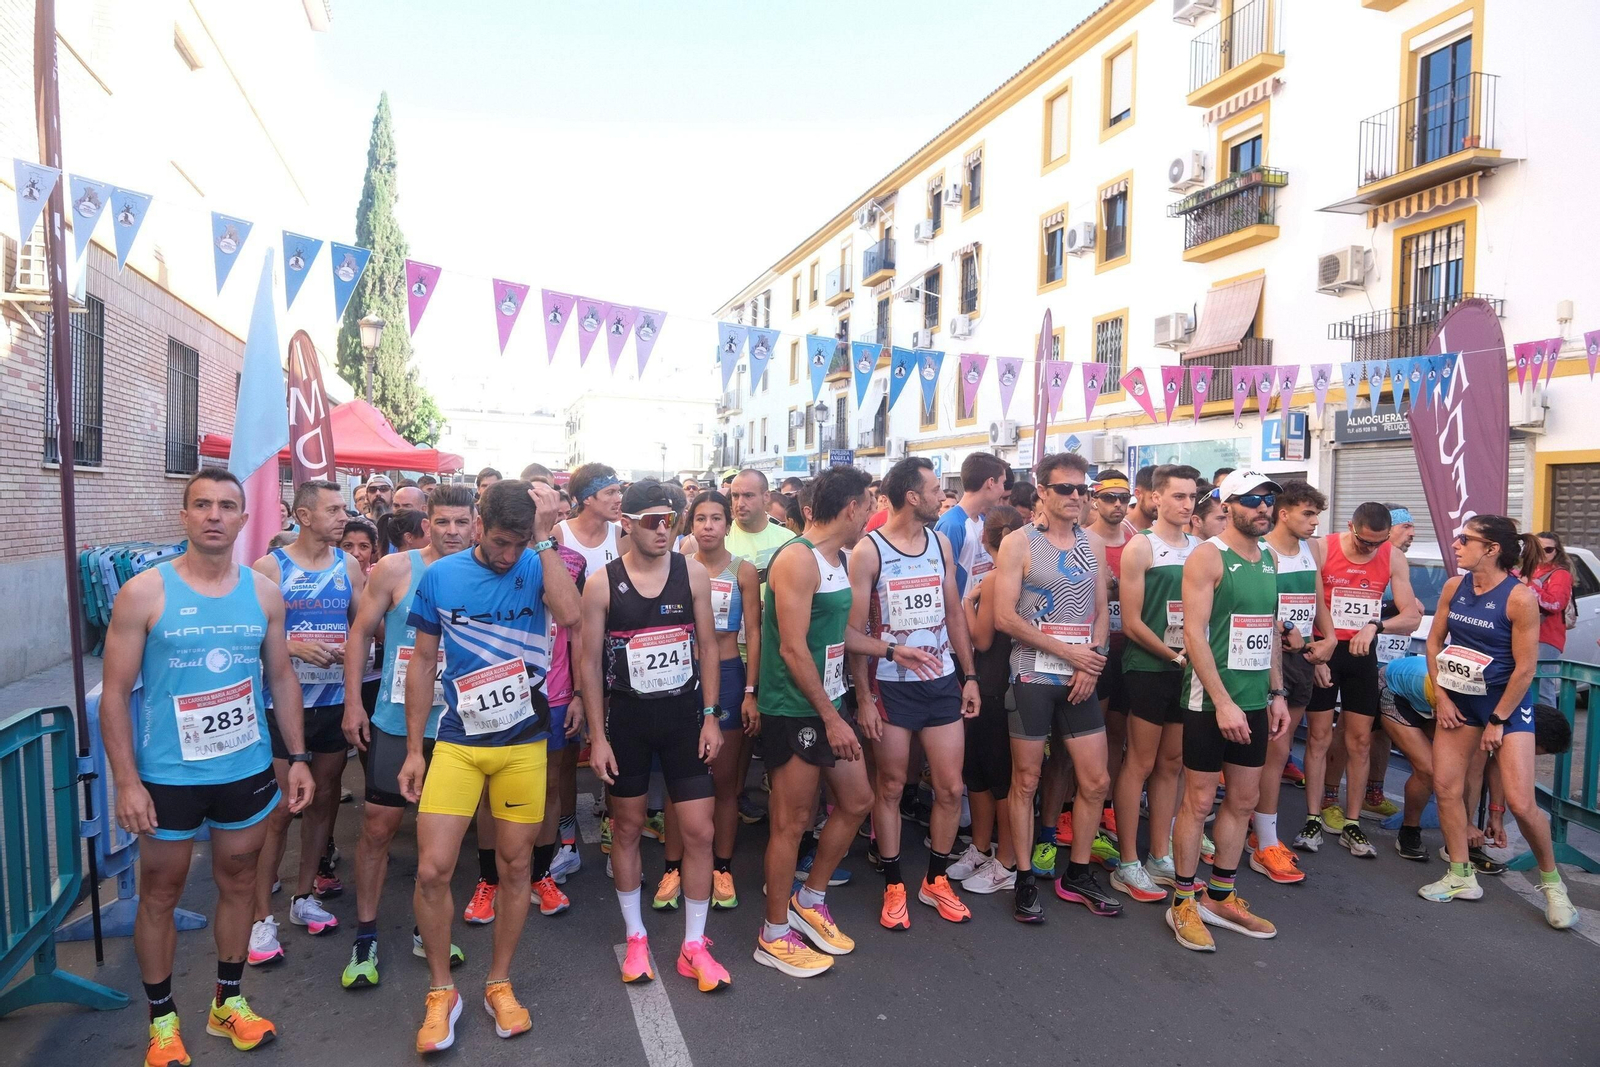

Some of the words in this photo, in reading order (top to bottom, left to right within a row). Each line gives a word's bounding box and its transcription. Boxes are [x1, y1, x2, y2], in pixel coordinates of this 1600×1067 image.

[1290, 414, 1301, 435] L
[1347, 413, 1402, 426] ALMOGUERA
[904, 594, 932, 610] 189
[1344, 602, 1370, 615] 251
[1290, 609, 1310, 621] 289
[1448, 612, 1494, 629] TROTASIERRA
[164, 625, 263, 639] KANINA
[1246, 634, 1269, 650] 669
[1388, 639, 1405, 651] 252
[168, 656, 203, 669] Raúl
[646, 650, 680, 671] 224
[1448, 661, 1470, 678] 663
[188, 695, 211, 705] CARRERA
[477, 685, 515, 712] 116
[202, 708, 244, 735] 283
